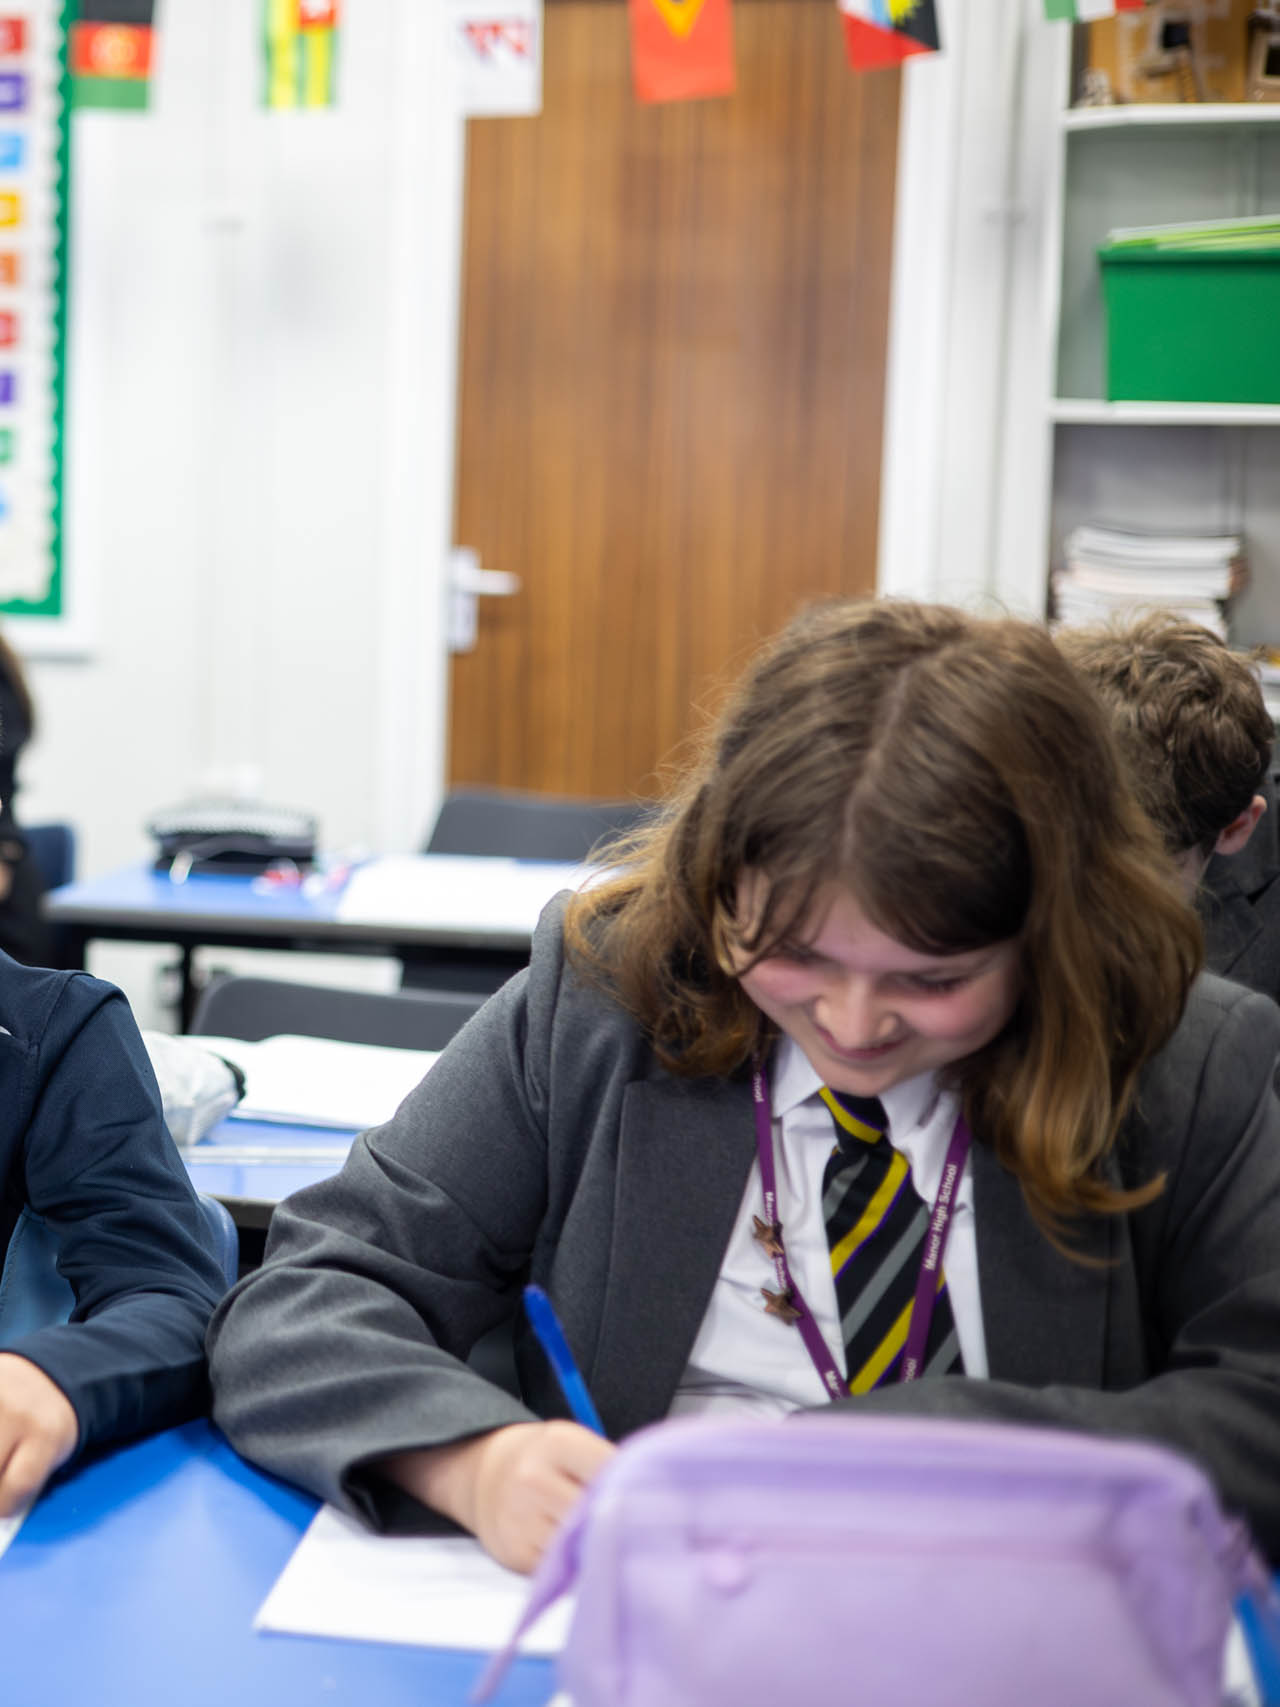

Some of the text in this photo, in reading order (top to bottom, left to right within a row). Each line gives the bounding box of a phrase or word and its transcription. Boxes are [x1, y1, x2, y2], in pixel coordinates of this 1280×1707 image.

[923, 1163, 958, 1271] Manor High School
